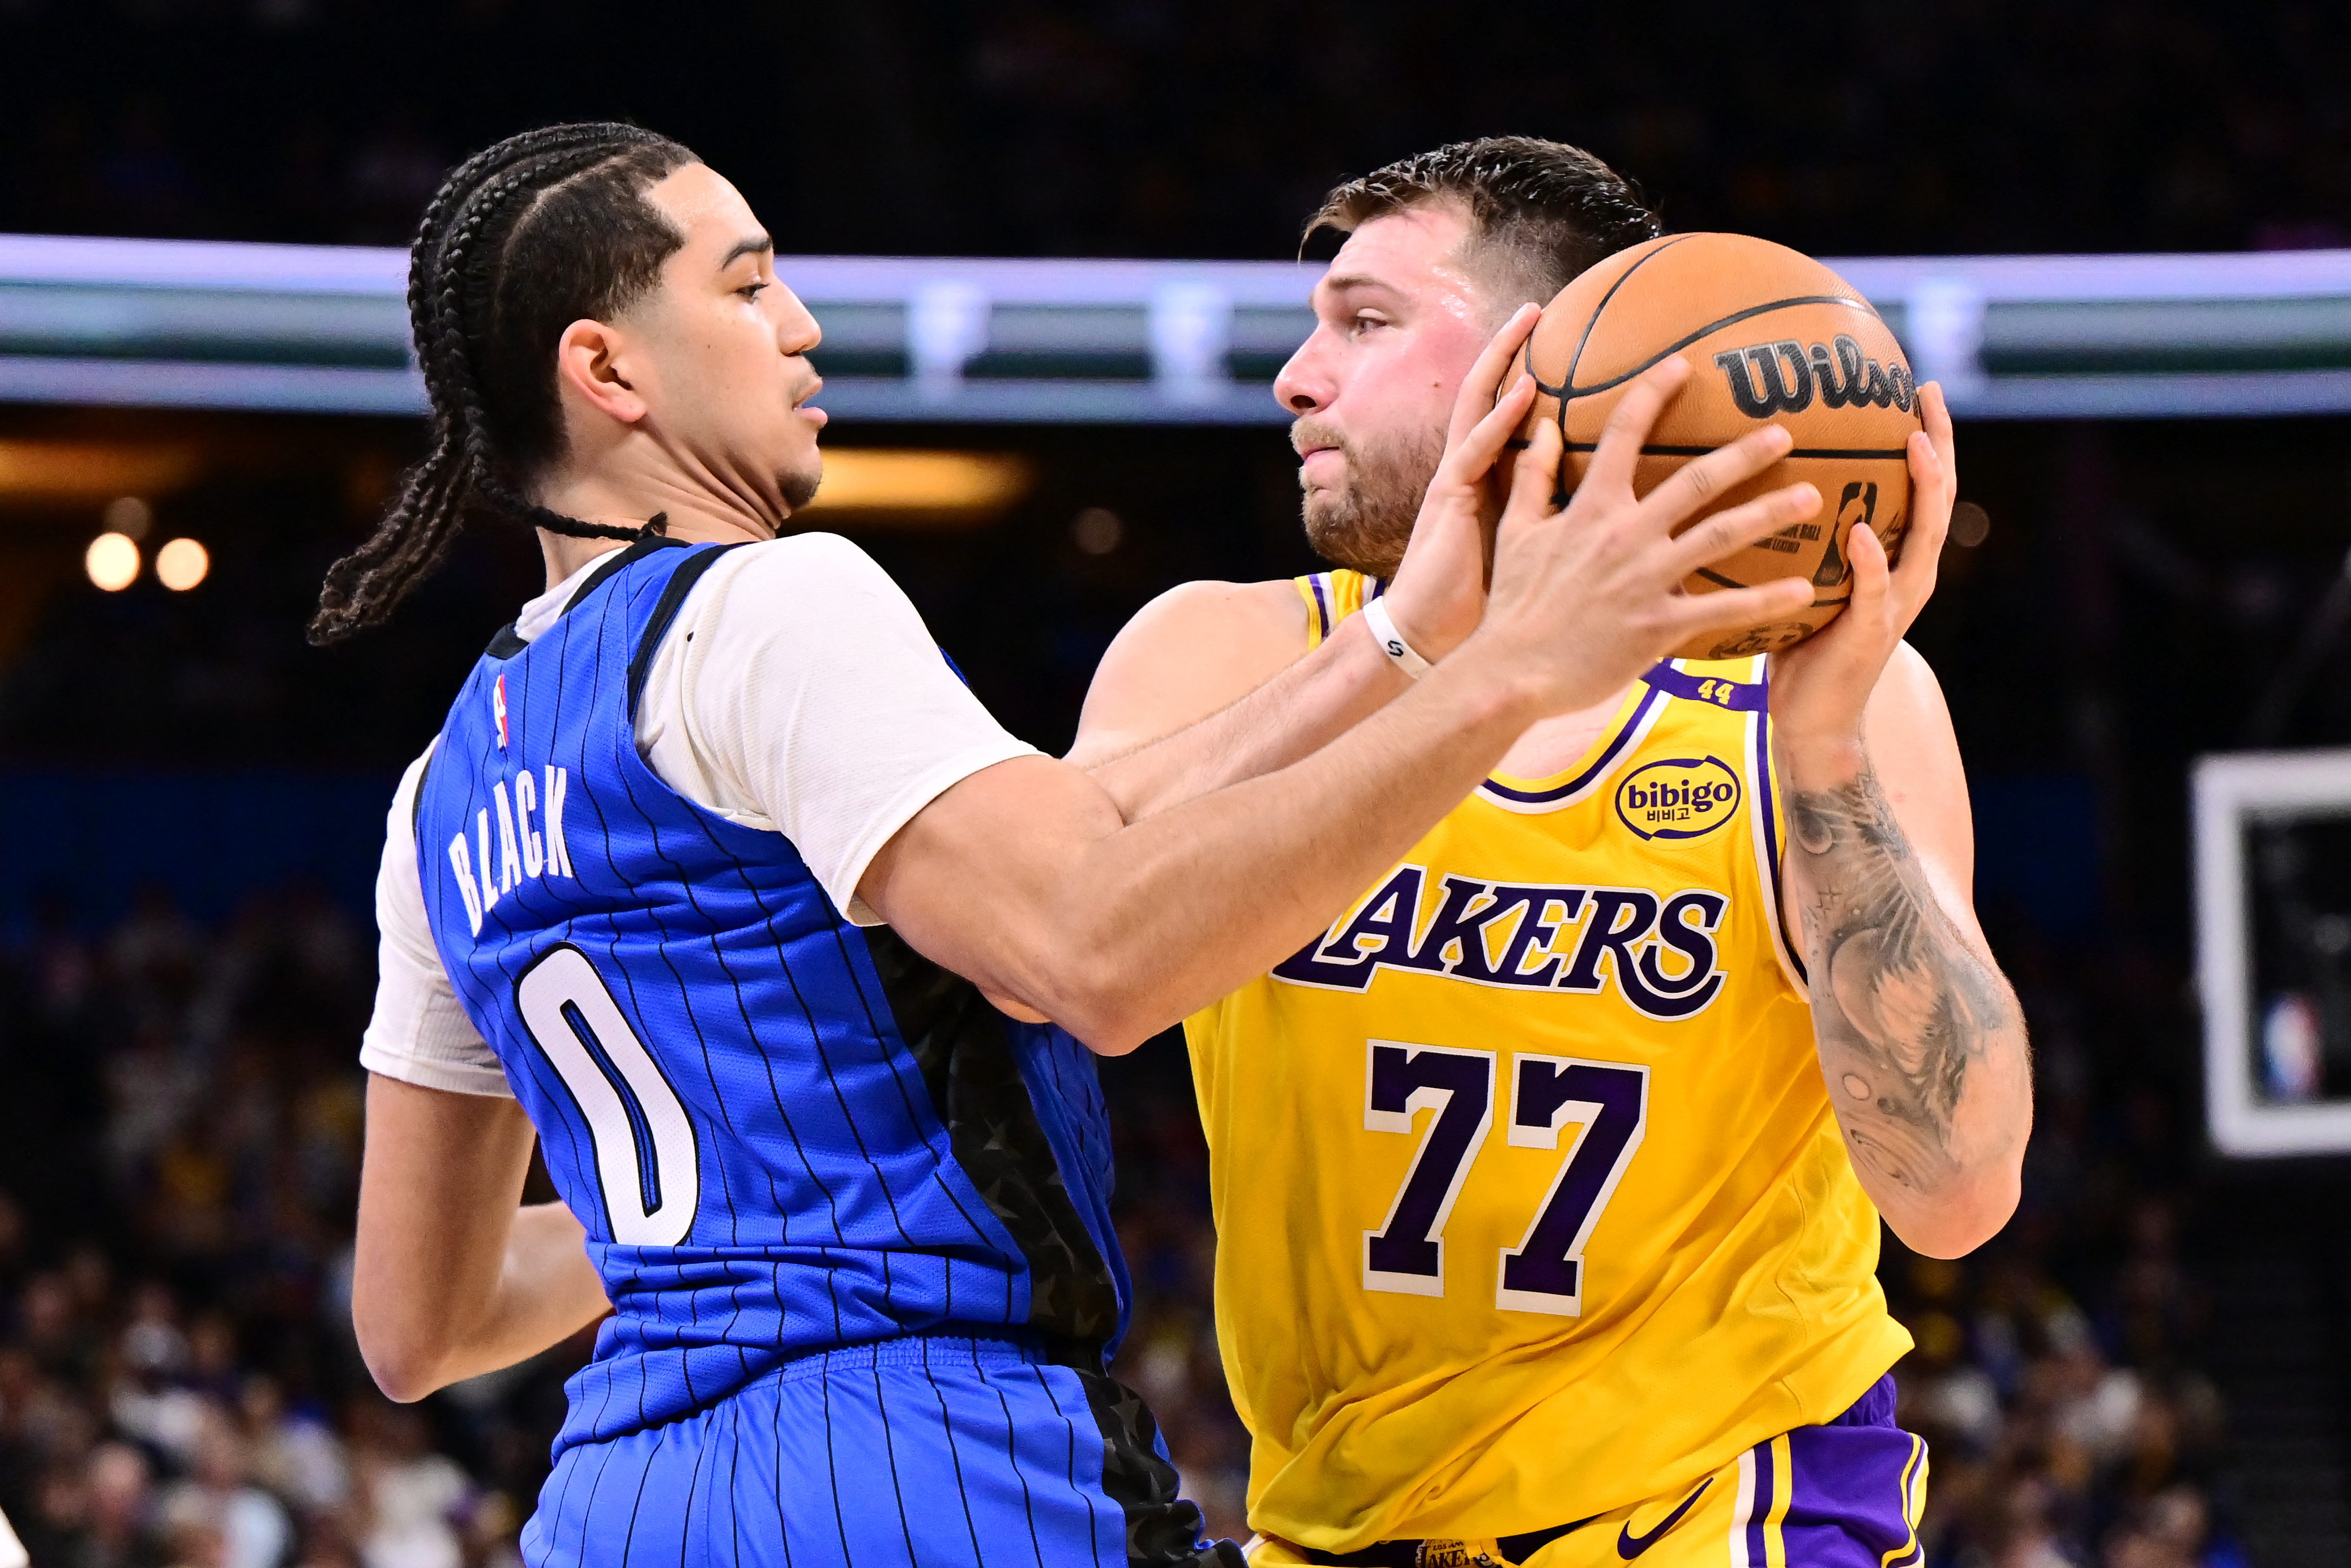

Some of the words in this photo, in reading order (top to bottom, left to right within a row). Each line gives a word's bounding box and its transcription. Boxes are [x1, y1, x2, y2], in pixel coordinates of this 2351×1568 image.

[1713, 334, 1920, 419] Wilso
[1698, 680, 1734, 704] 44
[1628, 779, 1733, 812] bibigo
[1647, 808, 1691, 823] 비비고
[448, 765, 572, 938] BLACK
[514, 942, 700, 1246] 0
[1363, 1039, 1651, 1318] 77
